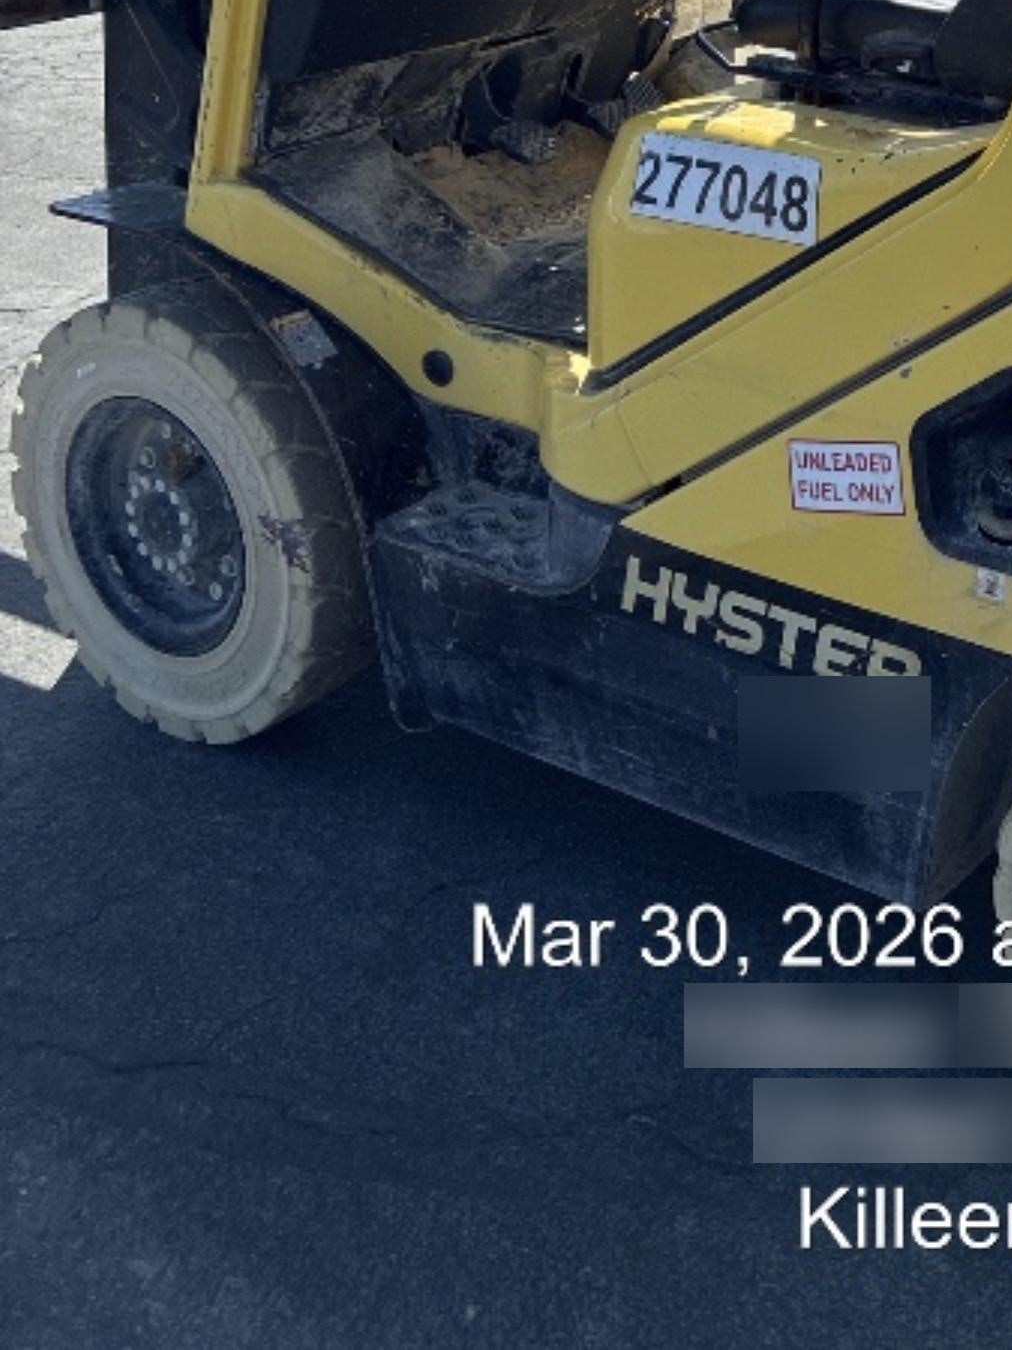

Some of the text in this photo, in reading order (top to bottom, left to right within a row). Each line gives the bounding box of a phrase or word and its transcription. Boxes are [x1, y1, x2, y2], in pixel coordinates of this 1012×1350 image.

[630, 149, 808, 233] 277048
[794, 450, 893, 474] UNLEADED
[796, 479, 896, 505] FUEL ONLY
